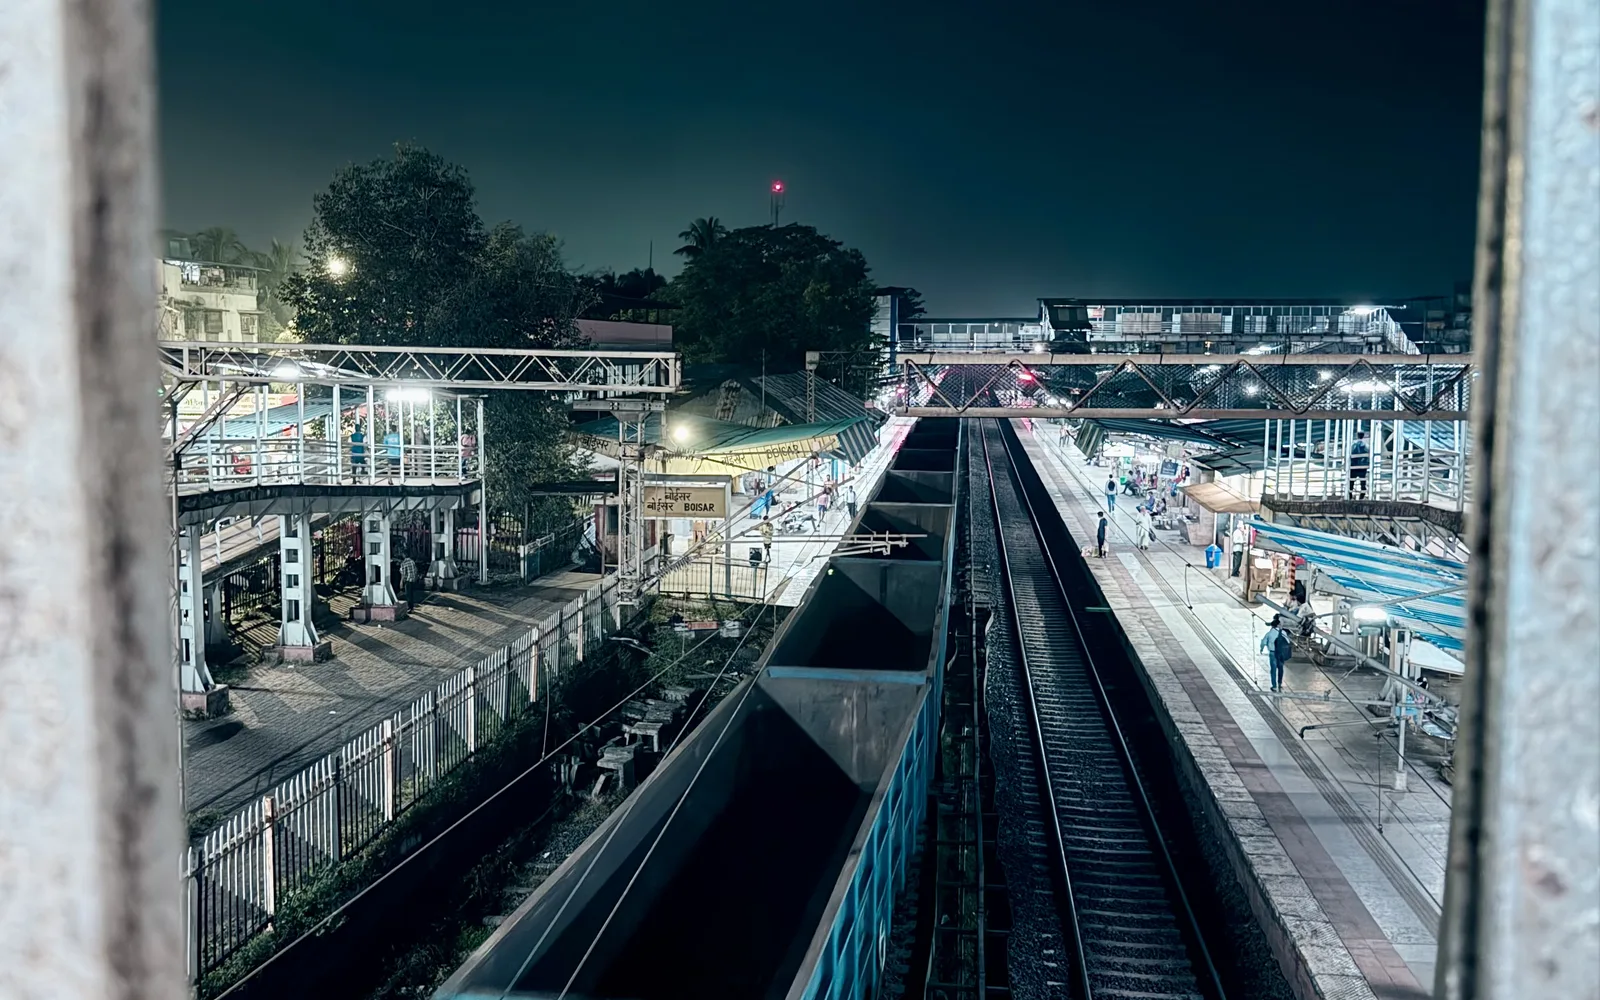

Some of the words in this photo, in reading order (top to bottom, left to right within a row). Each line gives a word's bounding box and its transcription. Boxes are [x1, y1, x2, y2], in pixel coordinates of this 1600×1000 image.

[765, 444, 799, 460] BOISAR
[664, 487, 692, 502] बोईसर
[646, 497, 675, 512] बोईसर
[684, 502, 715, 512] BOISAR
